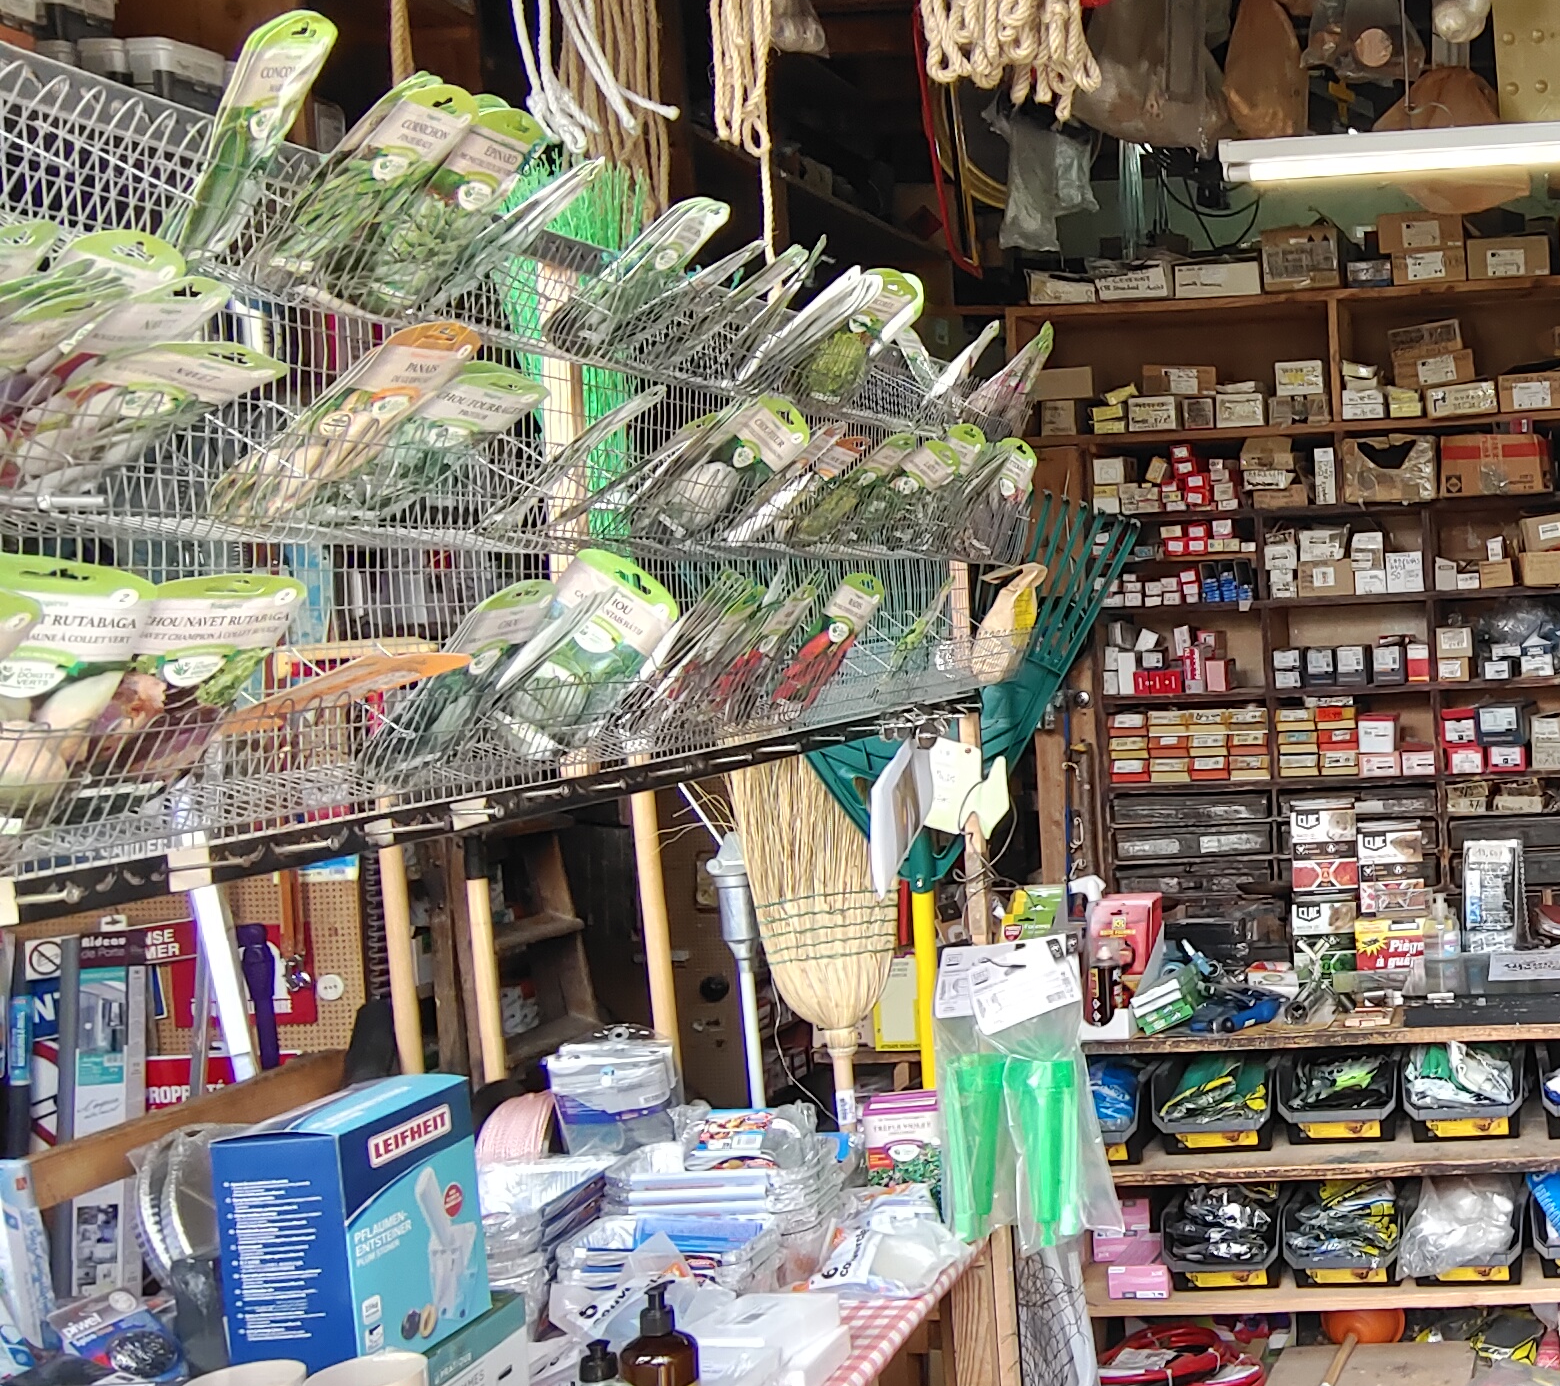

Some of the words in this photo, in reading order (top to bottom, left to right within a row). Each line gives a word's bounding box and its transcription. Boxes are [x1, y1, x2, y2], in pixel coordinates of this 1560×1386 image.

[53, 616, 137, 629] RUTABAGA
[188, 614, 226, 628] NAVET
[229, 611, 290, 627] RUTABAGA
[67, 634, 107, 645] COLLET
[105, 635, 132, 645] VERT
[16, 678, 49, 687] VERTS
[146, 929, 174, 946] SE
[1375, 955, 1385, 968] à
[372, 1110, 448, 1160] LEIFHEIT
[353, 1210, 408, 1244] PFLAUMEN-
[355, 1221, 412, 1257] ENTSTEINER
[821, 1266, 838, 1280] 6
